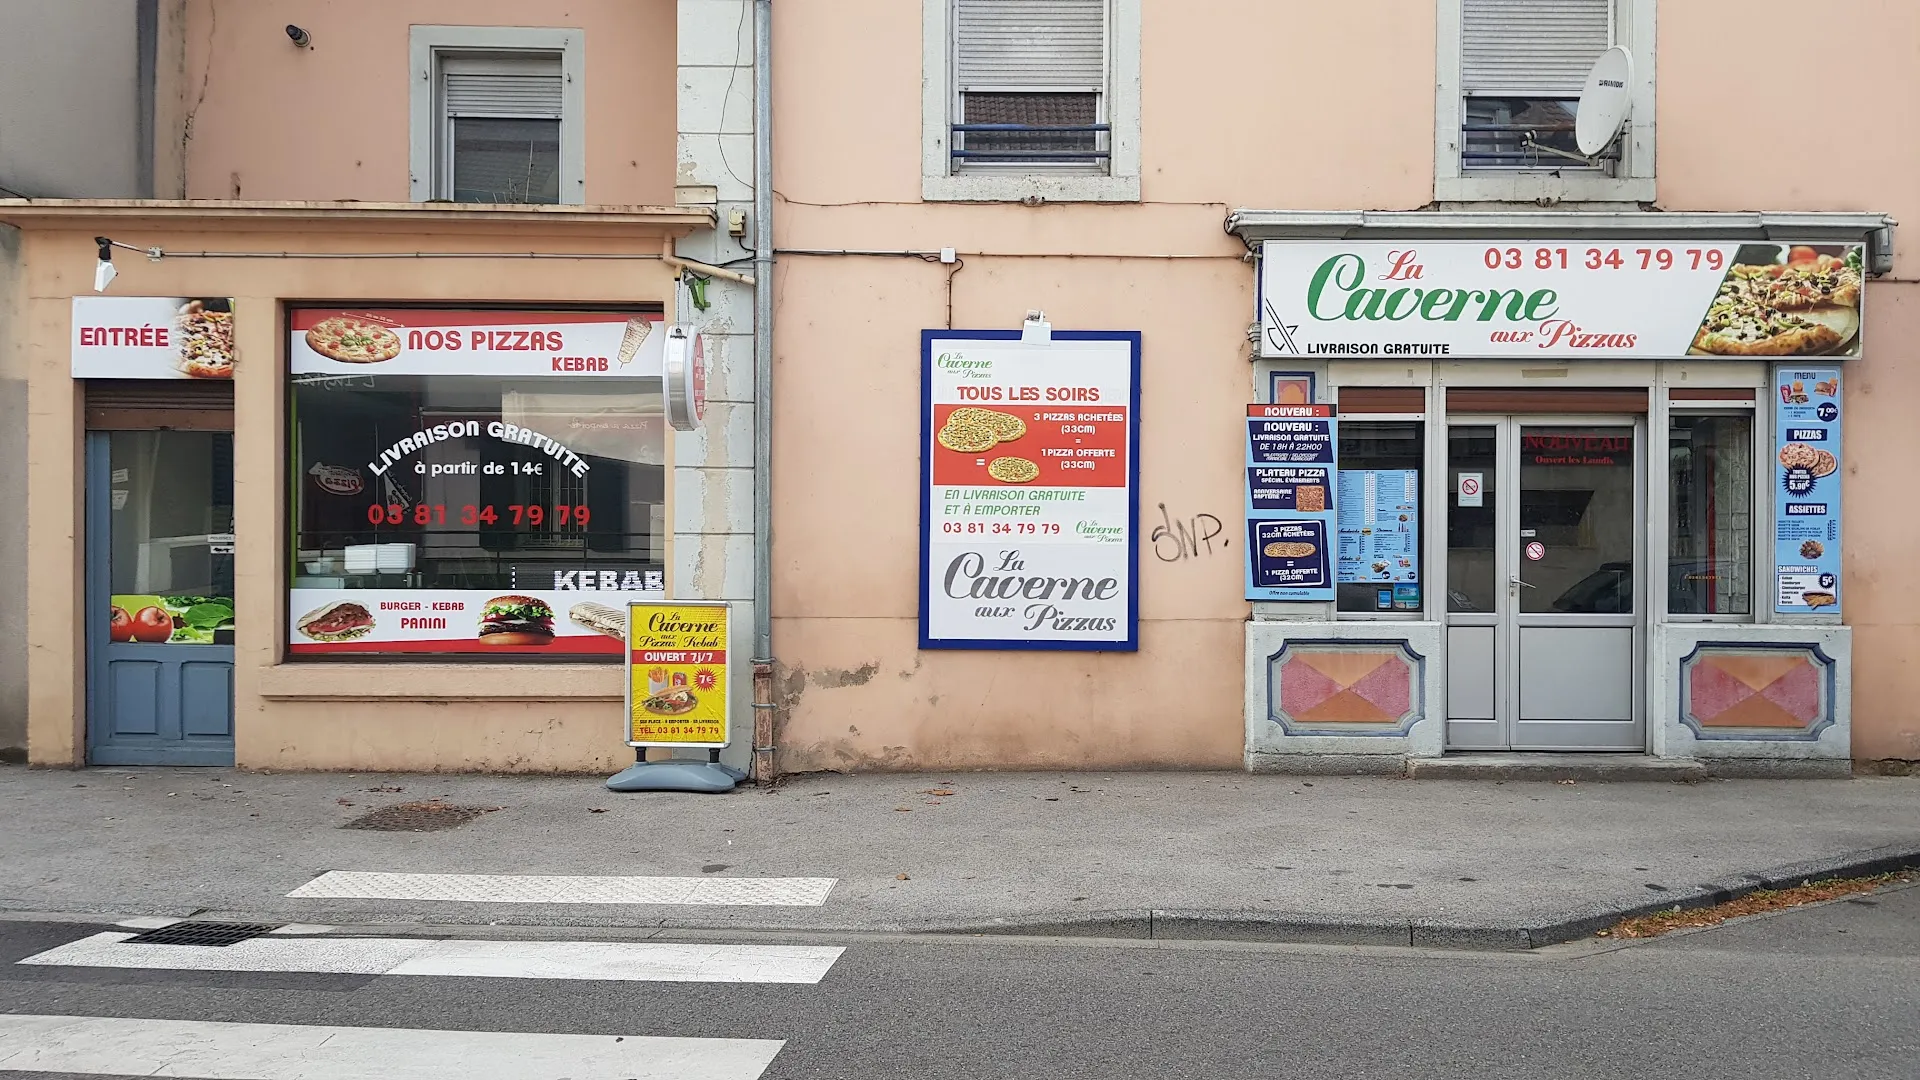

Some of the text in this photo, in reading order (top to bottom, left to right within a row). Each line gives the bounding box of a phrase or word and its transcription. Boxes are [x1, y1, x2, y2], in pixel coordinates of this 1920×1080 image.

[1378, 249, 1424, 281] La
[1484, 247, 1723, 270] 03 81 34 79 79
[1307, 253, 1560, 321] Caverne
[80, 323, 169, 347] ENTRÉE
[408, 330, 564, 351] NOS PIZZAS
[1490, 319, 1638, 349] aux Pizzas
[1307, 343, 1450, 354] LIVRAISON GRATUITE
[551, 357, 609, 372] KEBAB
[938, 353, 993, 369] Caverne
[956, 386, 1100, 402] TOUS LES SOIRS
[1033, 411, 1124, 422] 3 PIZZAS ACHETÉES
[1264, 407, 1312, 417] NOUVEAU
[1061, 425, 1096, 435] (33CM)
[1263, 422, 1312, 432] NOUVEAU
[1525, 433, 1630, 450] NOUVEAU
[1793, 430, 1822, 440] PIZZAS
[367, 420, 591, 479] LIVRAISON GRATUITE
[1041, 449, 1116, 457] 1 PIZZA OFFERTE
[1296, 443, 1323, 451] 22H00
[1060, 460, 1096, 470] (33CM)
[1535, 456, 1614, 465] Ouvert les Lundis
[415, 460, 543, 477] à partir de 14€
[1256, 469, 1325, 477] PLATEAU PIZZA
[944, 489, 1086, 501] EN LIVRAISON GRATUITE
[367, 504, 591, 525] 03 81 34 79 79
[944, 502, 1041, 516] ET À EMPORTER
[1789, 505, 1826, 514] ASSIETTES
[943, 523, 1060, 535] 03 81 34 79 79
[993, 549, 1025, 572] La
[554, 569, 664, 592] KEBAB
[944, 551, 1120, 601] Caverne
[380, 602, 421, 610] BURGER
[432, 602, 464, 610] KEBAB
[648, 612, 718, 633] Caverne
[669, 611, 681, 621] La
[975, 604, 1117, 631] aux Pizzas
[400, 617, 447, 630] PANINI
[639, 635, 677, 647] Pizzas
[683, 635, 719, 648] Kebab
[644, 652, 714, 664] OUVERT 7j/7
[699, 675, 712, 684] 7€
